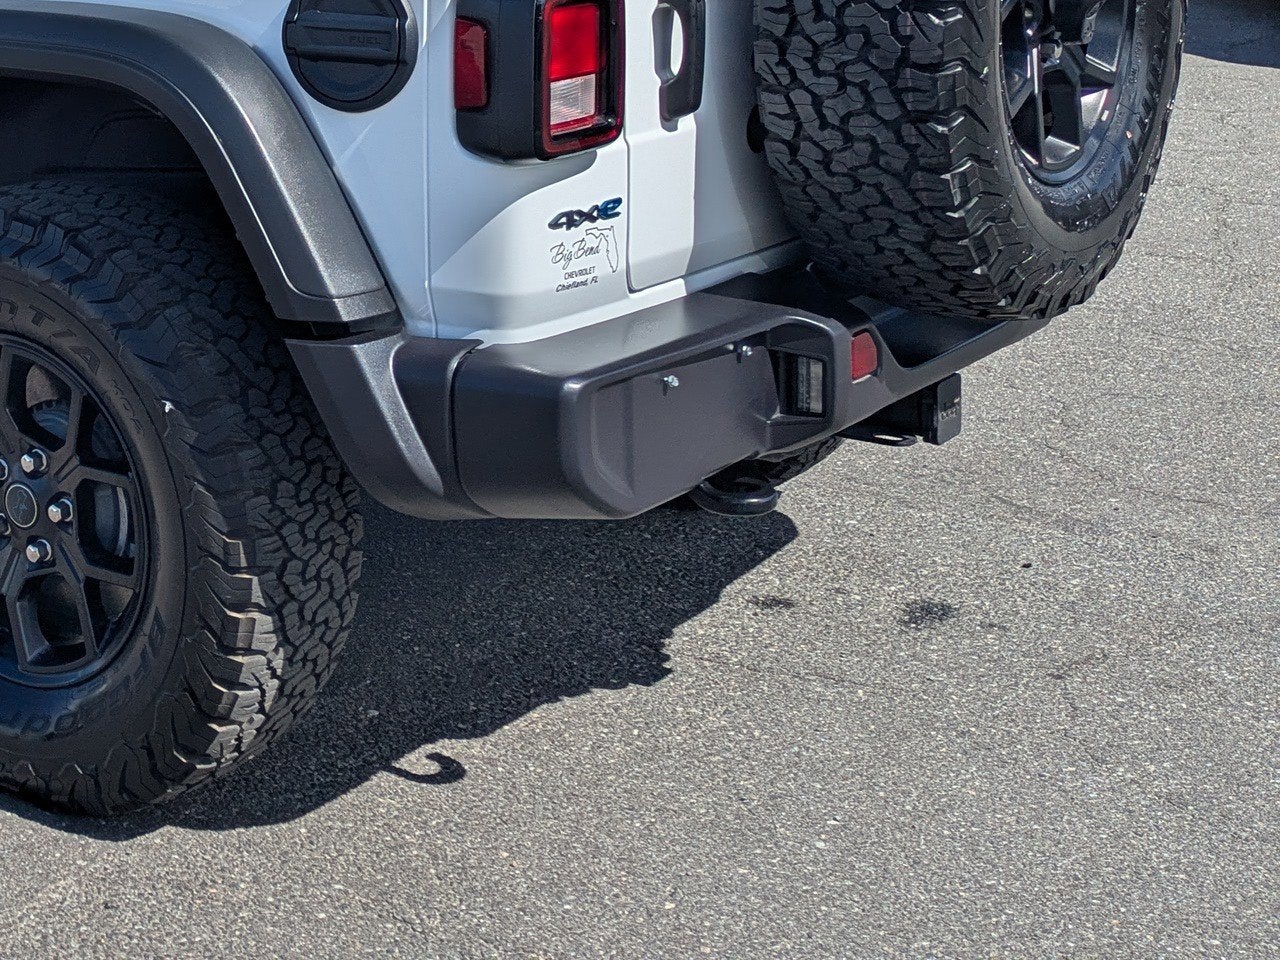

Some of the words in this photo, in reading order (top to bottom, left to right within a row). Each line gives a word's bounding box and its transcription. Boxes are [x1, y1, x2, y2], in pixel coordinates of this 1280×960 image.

[550, 242, 573, 270] Big
[572, 238, 602, 260] Bend
[563, 266, 596, 281] CHEVROLET
